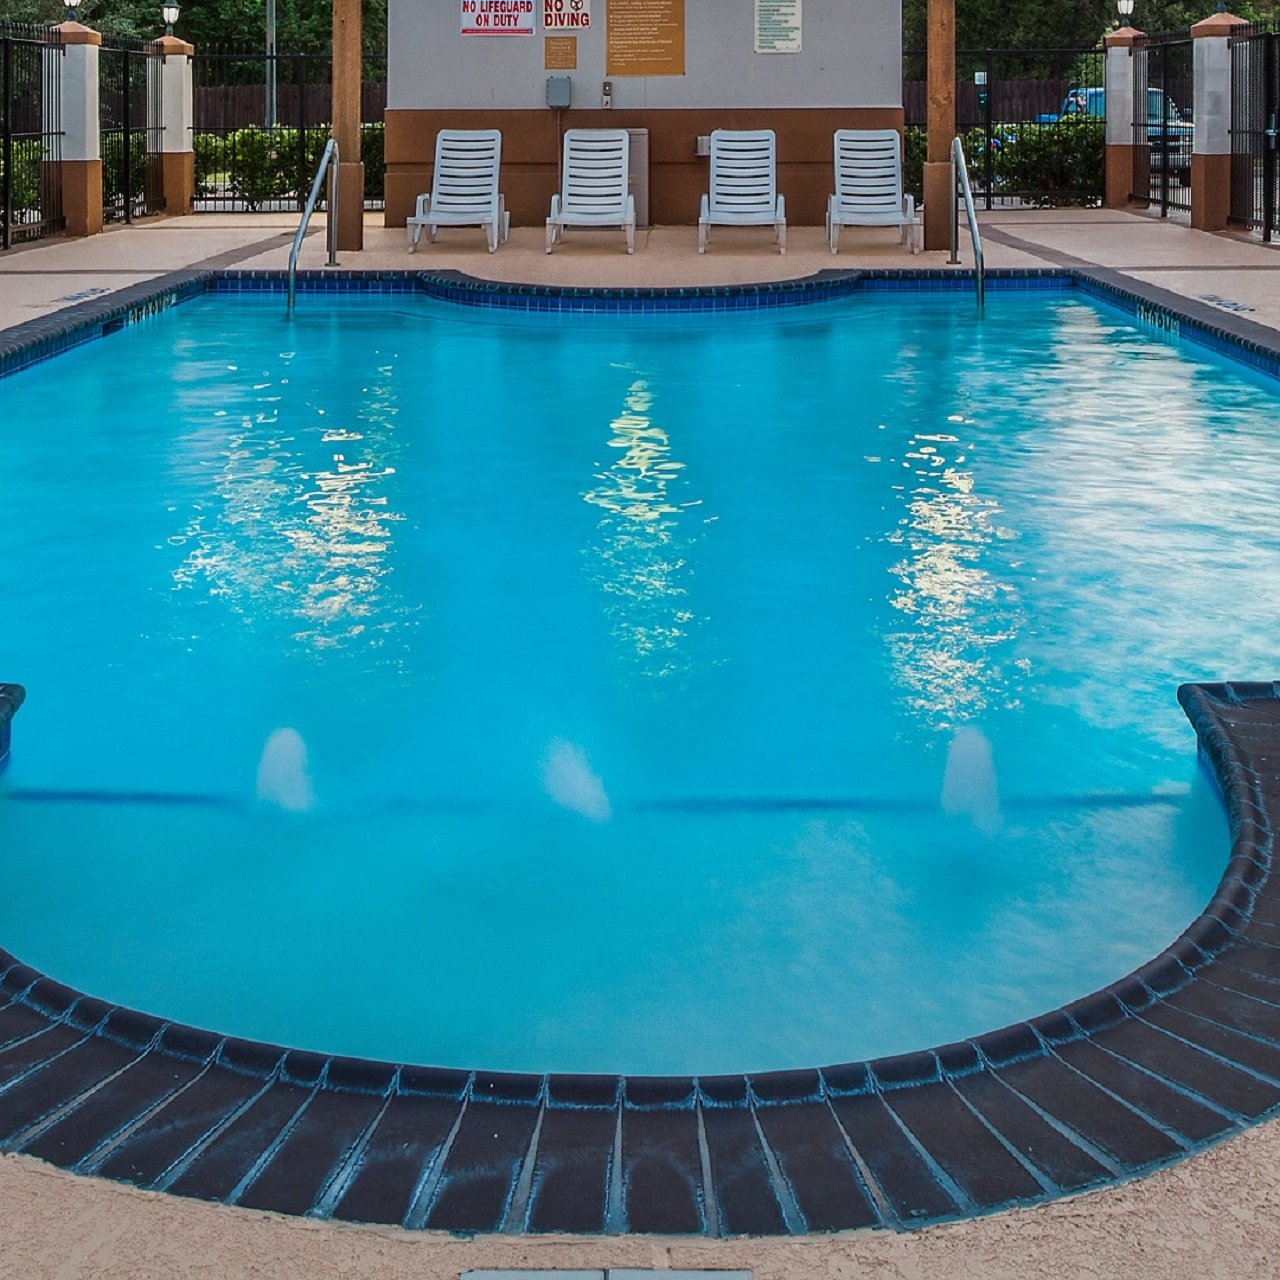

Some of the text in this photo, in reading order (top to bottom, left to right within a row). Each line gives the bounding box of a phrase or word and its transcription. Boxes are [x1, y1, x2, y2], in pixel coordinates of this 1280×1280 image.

[462, 0, 533, 13] NO LIFEGUARD
[544, 0, 564, 12] NO
[476, 14, 520, 26] ON DUTY
[544, 13, 590, 26] DIVING
